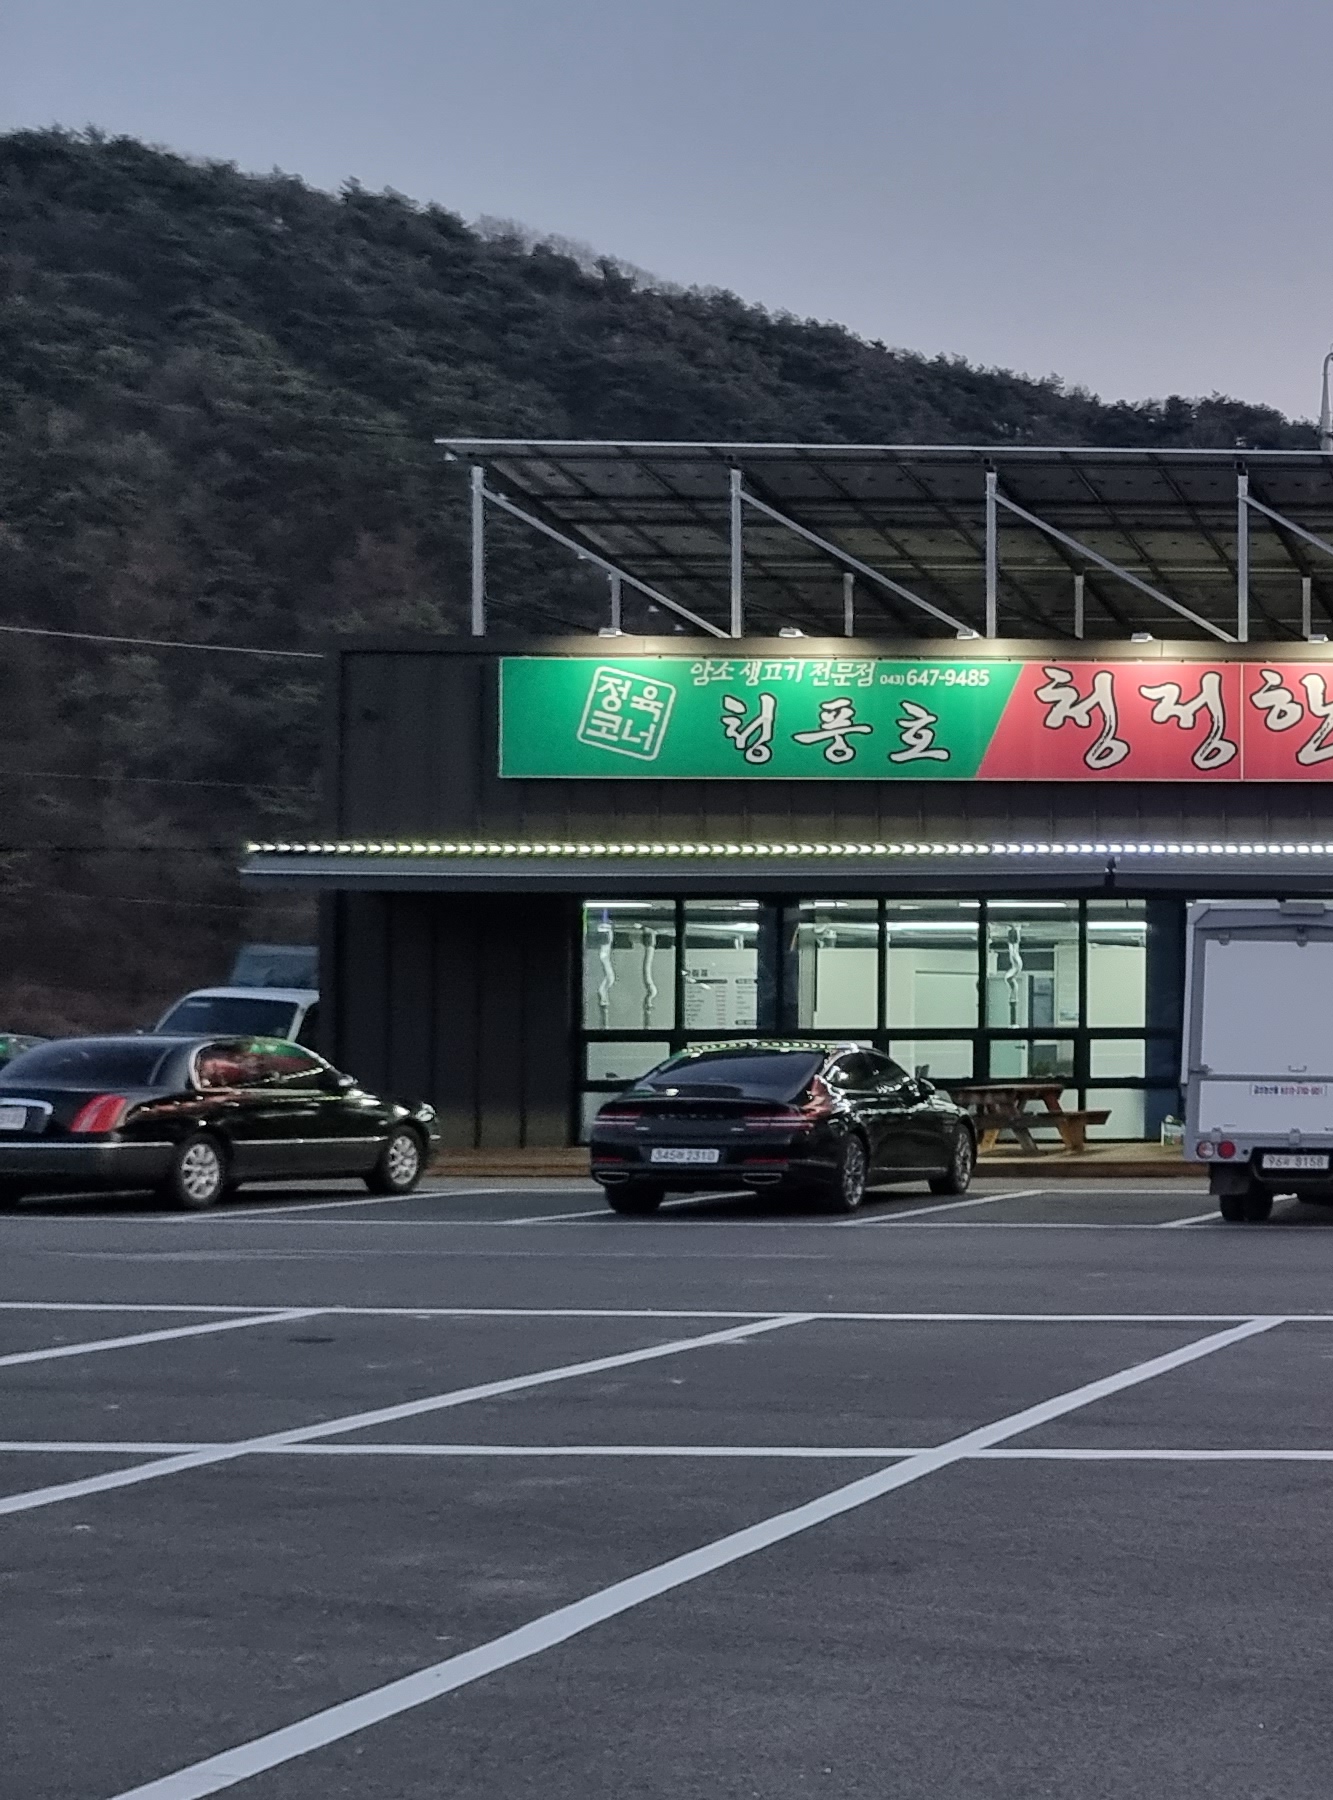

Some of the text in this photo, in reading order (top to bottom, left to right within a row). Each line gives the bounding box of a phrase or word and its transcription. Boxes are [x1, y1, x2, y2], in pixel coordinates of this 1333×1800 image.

[690, 662, 735, 686] 암소
[739, 662, 804, 686] 생고기
[808, 661, 874, 687] 전문점
[596, 676, 665, 722] 정육
[585, 709, 657, 751] 코너
[721, 693, 950, 764] 청풍호
